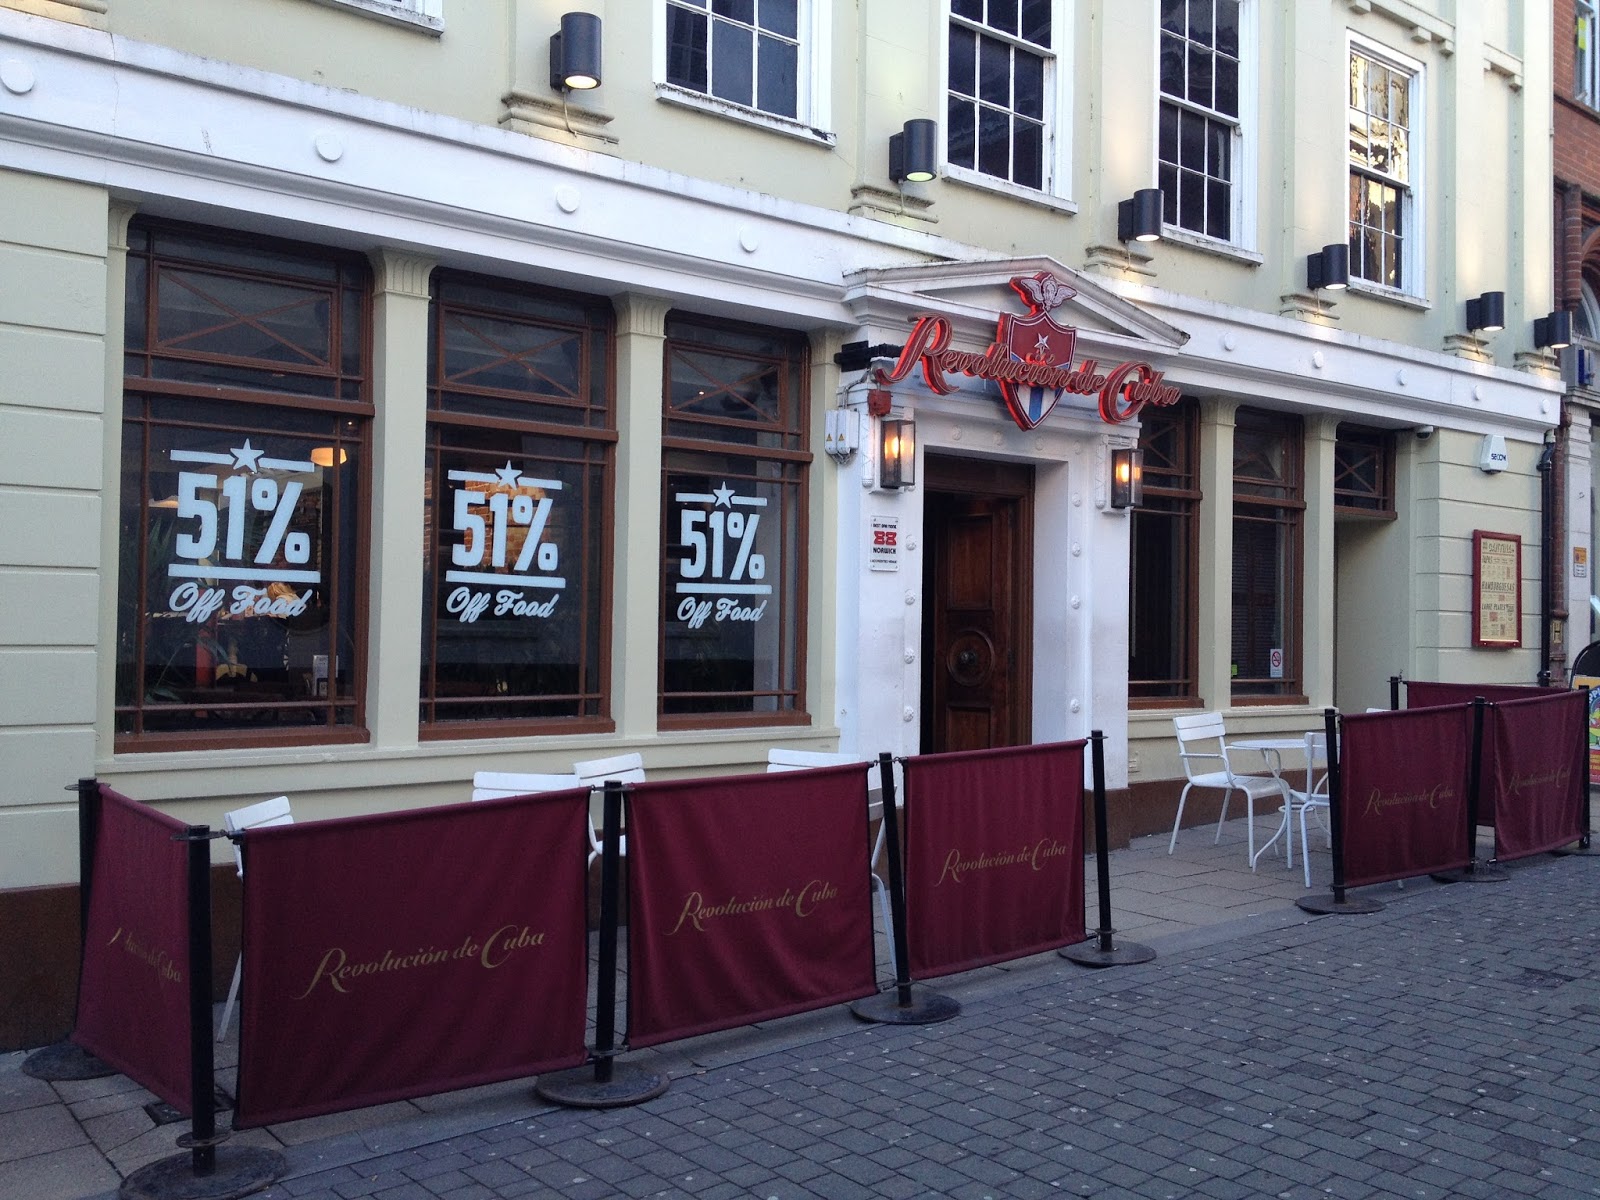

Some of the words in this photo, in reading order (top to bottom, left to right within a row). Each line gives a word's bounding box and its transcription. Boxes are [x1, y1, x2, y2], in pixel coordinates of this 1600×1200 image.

[1073, 360, 1108, 395] de
[1099, 361, 1183, 425] Cuba
[176, 472, 311, 564] 51%
[452, 489, 558, 571] 51%
[680, 509, 765, 581] 51%
[168, 582, 226, 623] Off
[230, 585, 313, 617] Food
[446, 586, 491, 623] Off
[494, 590, 559, 618] Food
[677, 596, 713, 629] Off
[715, 598, 767, 622] Food
[1016, 845, 1031, 863] de
[1031, 838, 1067, 871] Cuba
[775, 887, 795, 907] de
[796, 879, 838, 918] Cuba
[453, 936, 479, 959] de
[480, 924, 545, 969] Cuba
